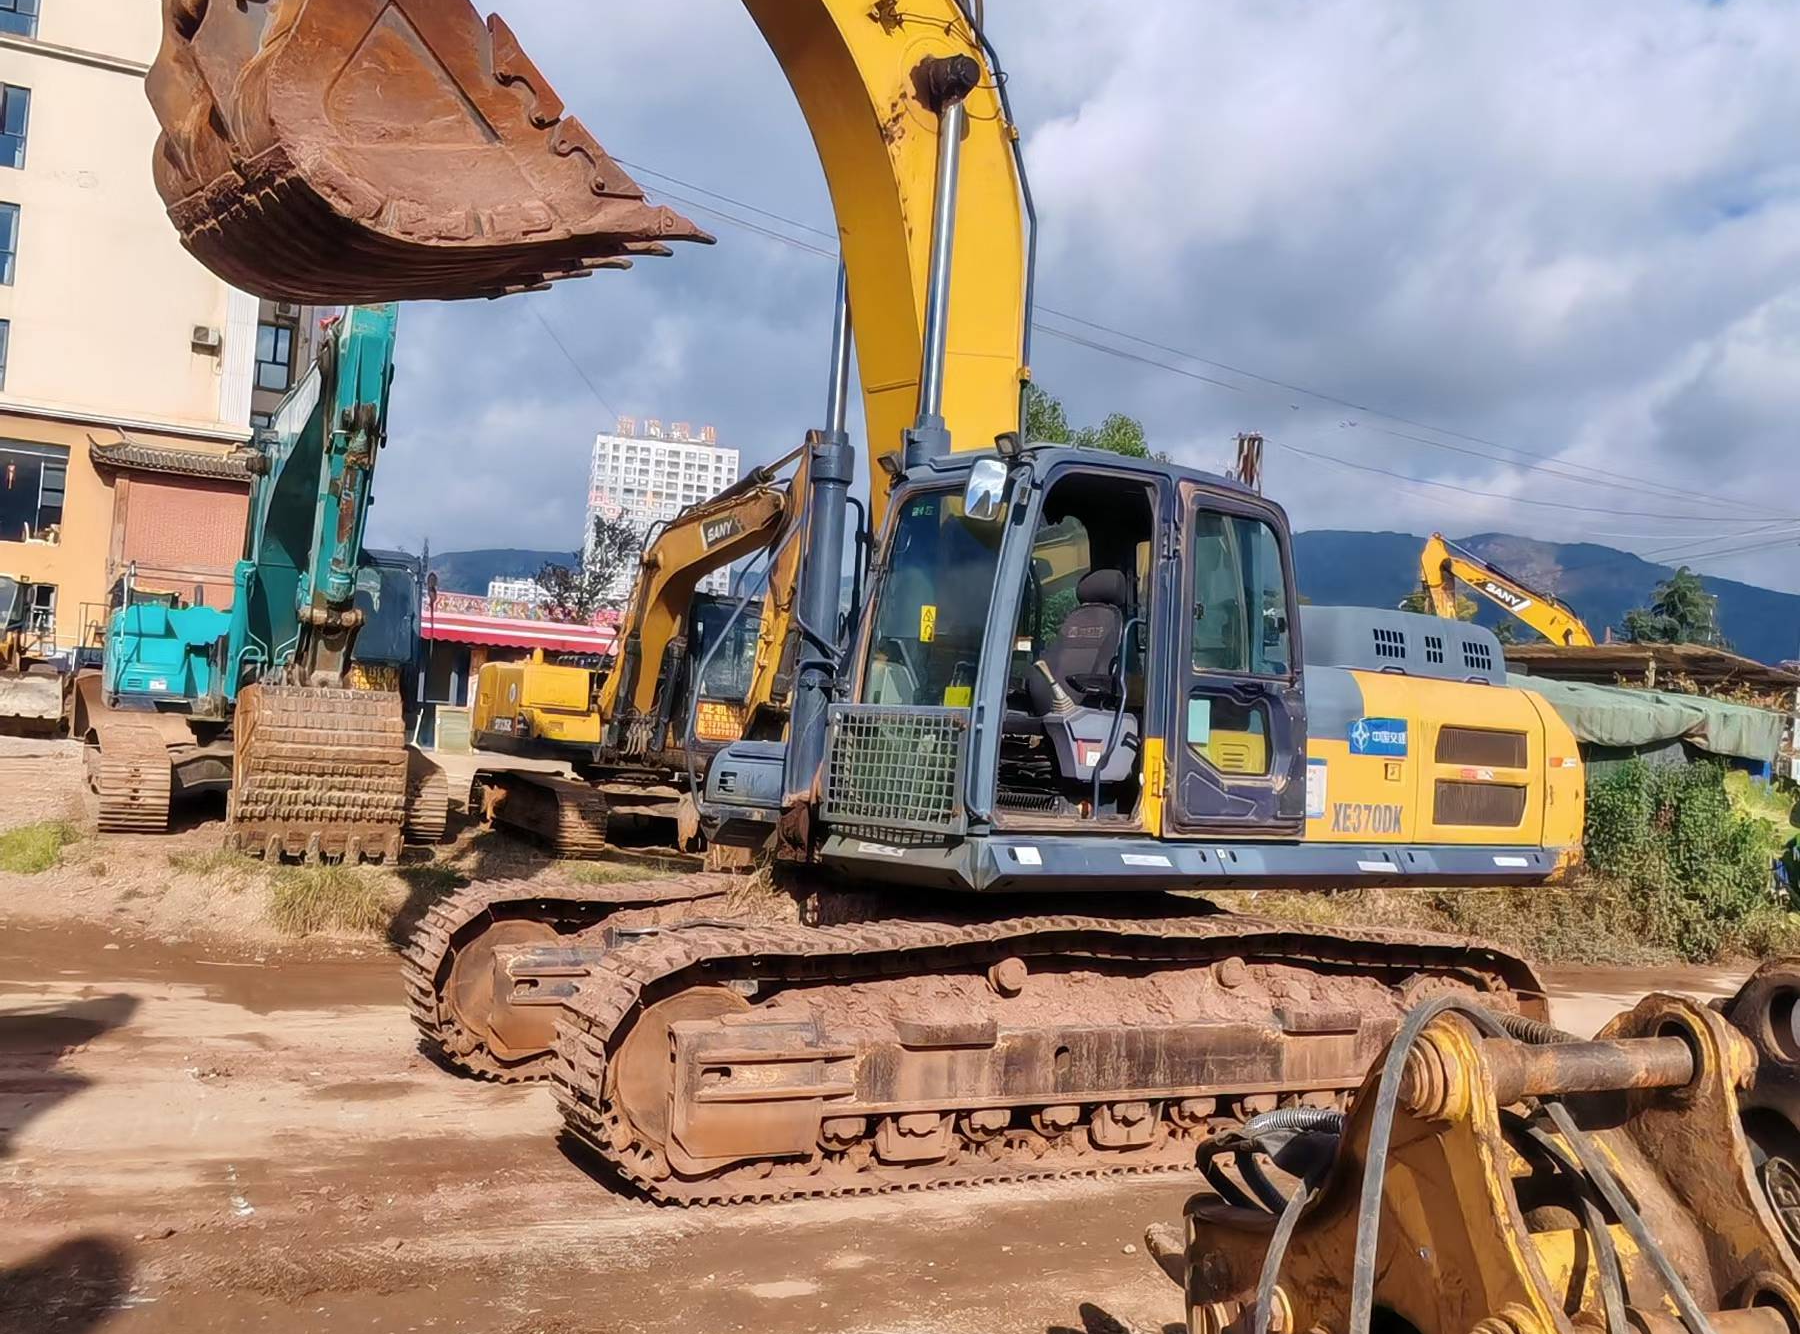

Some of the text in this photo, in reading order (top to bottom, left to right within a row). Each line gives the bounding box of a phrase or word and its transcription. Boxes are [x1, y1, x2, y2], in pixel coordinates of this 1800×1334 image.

[707, 519, 733, 543] SANY
[1485, 582, 1521, 606] SANY
[1331, 802, 1404, 835] XE370DK
